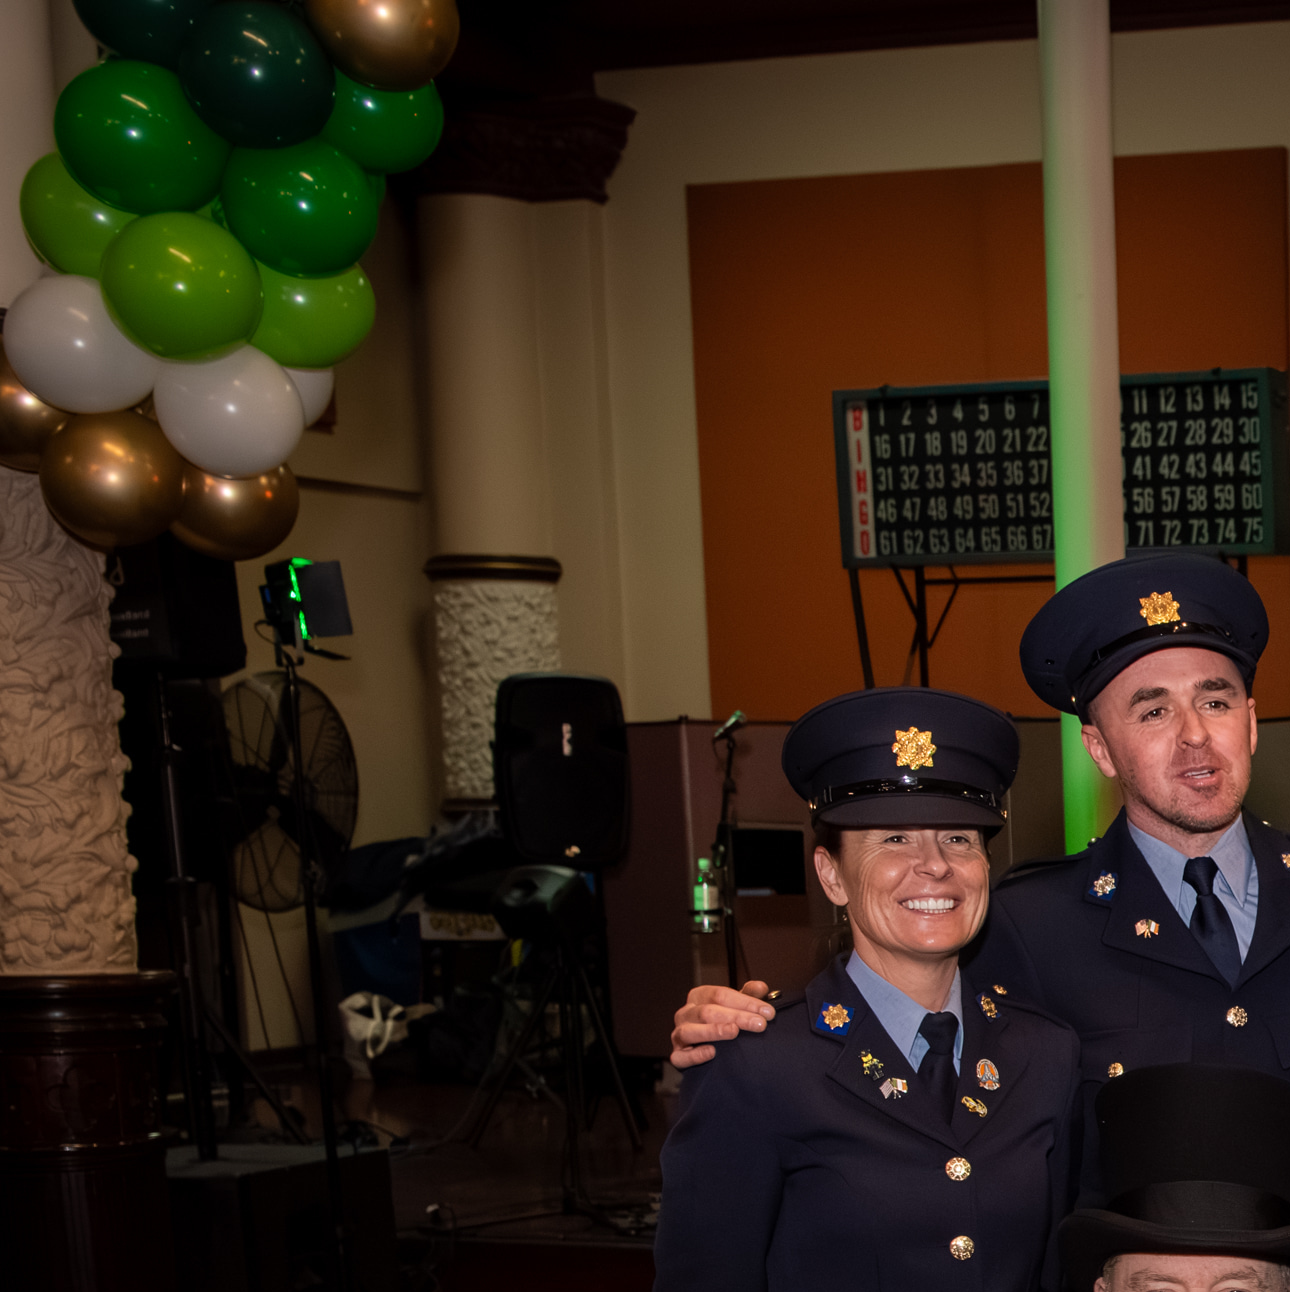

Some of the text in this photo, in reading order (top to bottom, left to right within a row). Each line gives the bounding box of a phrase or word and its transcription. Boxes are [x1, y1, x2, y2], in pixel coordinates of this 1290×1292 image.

[879, 400, 885, 426] 1
[901, 399, 912, 426] 2
[927, 399, 937, 425] 3
[952, 398, 963, 422] 4
[978, 396, 989, 422] 5
[1004, 395, 1015, 421] 6
[1031, 393, 1040, 419] 7
[1132, 388, 1147, 415] 11
[1159, 387, 1176, 414] 12
[1186, 386, 1204, 412] 13
[1213, 384, 1232, 411] 14
[1241, 382, 1258, 410] 15
[874, 434, 891, 459] 16
[899, 432, 915, 457] 17
[924, 431, 941, 456] 18
[951, 429, 967, 455] 19
[975, 428, 995, 454] 20
[1002, 428, 1021, 453] 21
[1026, 426, 1048, 452] 22
[1130, 420, 1152, 448] 26
[1157, 420, 1178, 447] 27
[1184, 419, 1207, 446] 28
[1211, 418, 1234, 445] 29
[1238, 417, 1260, 444] 30
[876, 466, 893, 491] 31
[900, 465, 920, 490] 32
[925, 463, 945, 489] 33
[951, 462, 971, 488] 34
[976, 461, 997, 488] 35
[1003, 460, 1024, 486] 36
[1029, 459, 1048, 485] 37
[1132, 454, 1151, 481] 41
[1159, 453, 1180, 480] 42
[1185, 452, 1207, 479] 43
[1212, 451, 1234, 478] 44
[1239, 451, 1261, 477] 45
[877, 498, 897, 523] 46
[903, 497, 921, 522] 47
[928, 496, 947, 521] 48
[953, 494, 973, 520] 49
[978, 494, 999, 519] 50
[1006, 493, 1025, 518] 51
[1030, 492, 1050, 518] 52
[1132, 487, 1154, 514] 56
[1161, 486, 1181, 513] 57
[1186, 485, 1208, 512] 58
[1214, 484, 1235, 511] 59
[1241, 483, 1263, 510] 60
[880, 530, 898, 555] 61
[903, 529, 924, 554] 62
[929, 528, 949, 553] 63
[955, 527, 975, 552] 64
[981, 526, 1001, 552] 65
[1007, 525, 1027, 551] 66
[1032, 524, 1051, 550] 67
[1136, 520, 1154, 546] 71
[1160, 520, 1182, 545] 72
[1188, 519, 1209, 544] 73
[1215, 518, 1237, 544] 74
[1243, 518, 1263, 543] 75
